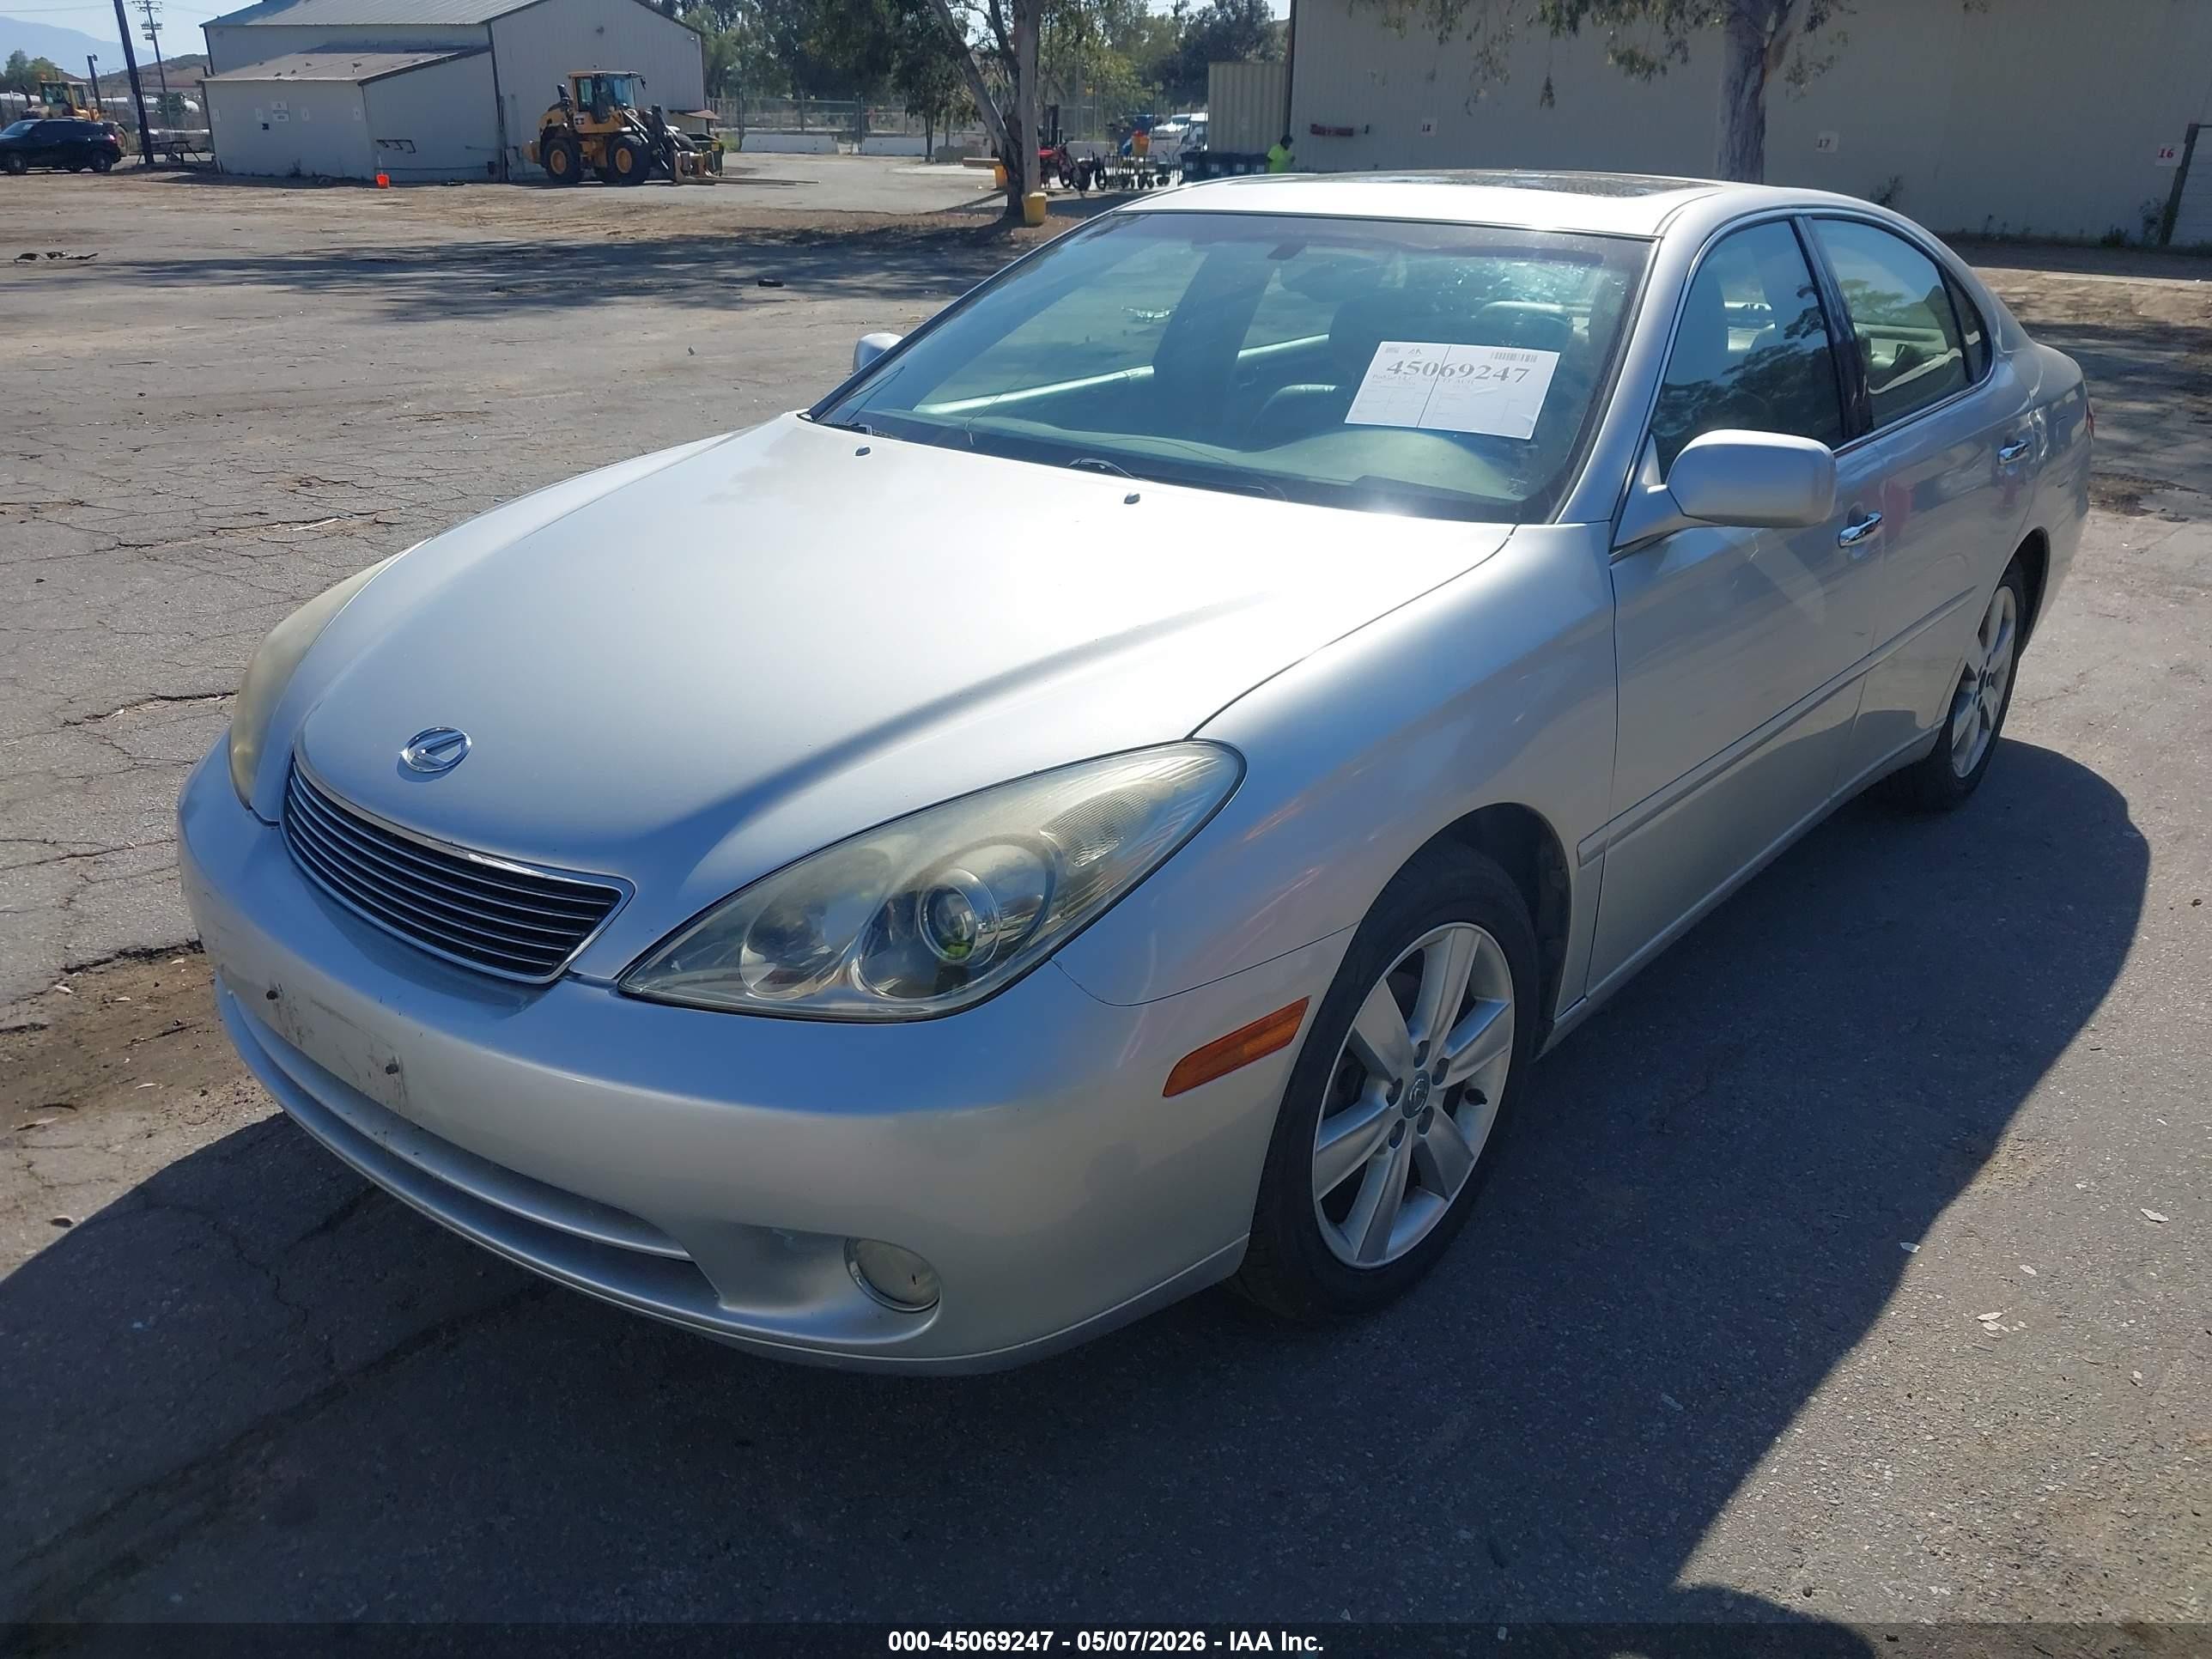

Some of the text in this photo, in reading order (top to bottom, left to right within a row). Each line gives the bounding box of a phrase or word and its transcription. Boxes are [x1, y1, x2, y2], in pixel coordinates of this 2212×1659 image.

[1818, 139, 1831, 149] 17
[2158, 148, 2174, 159] 16
[1386, 361, 1531, 383] 45069247
